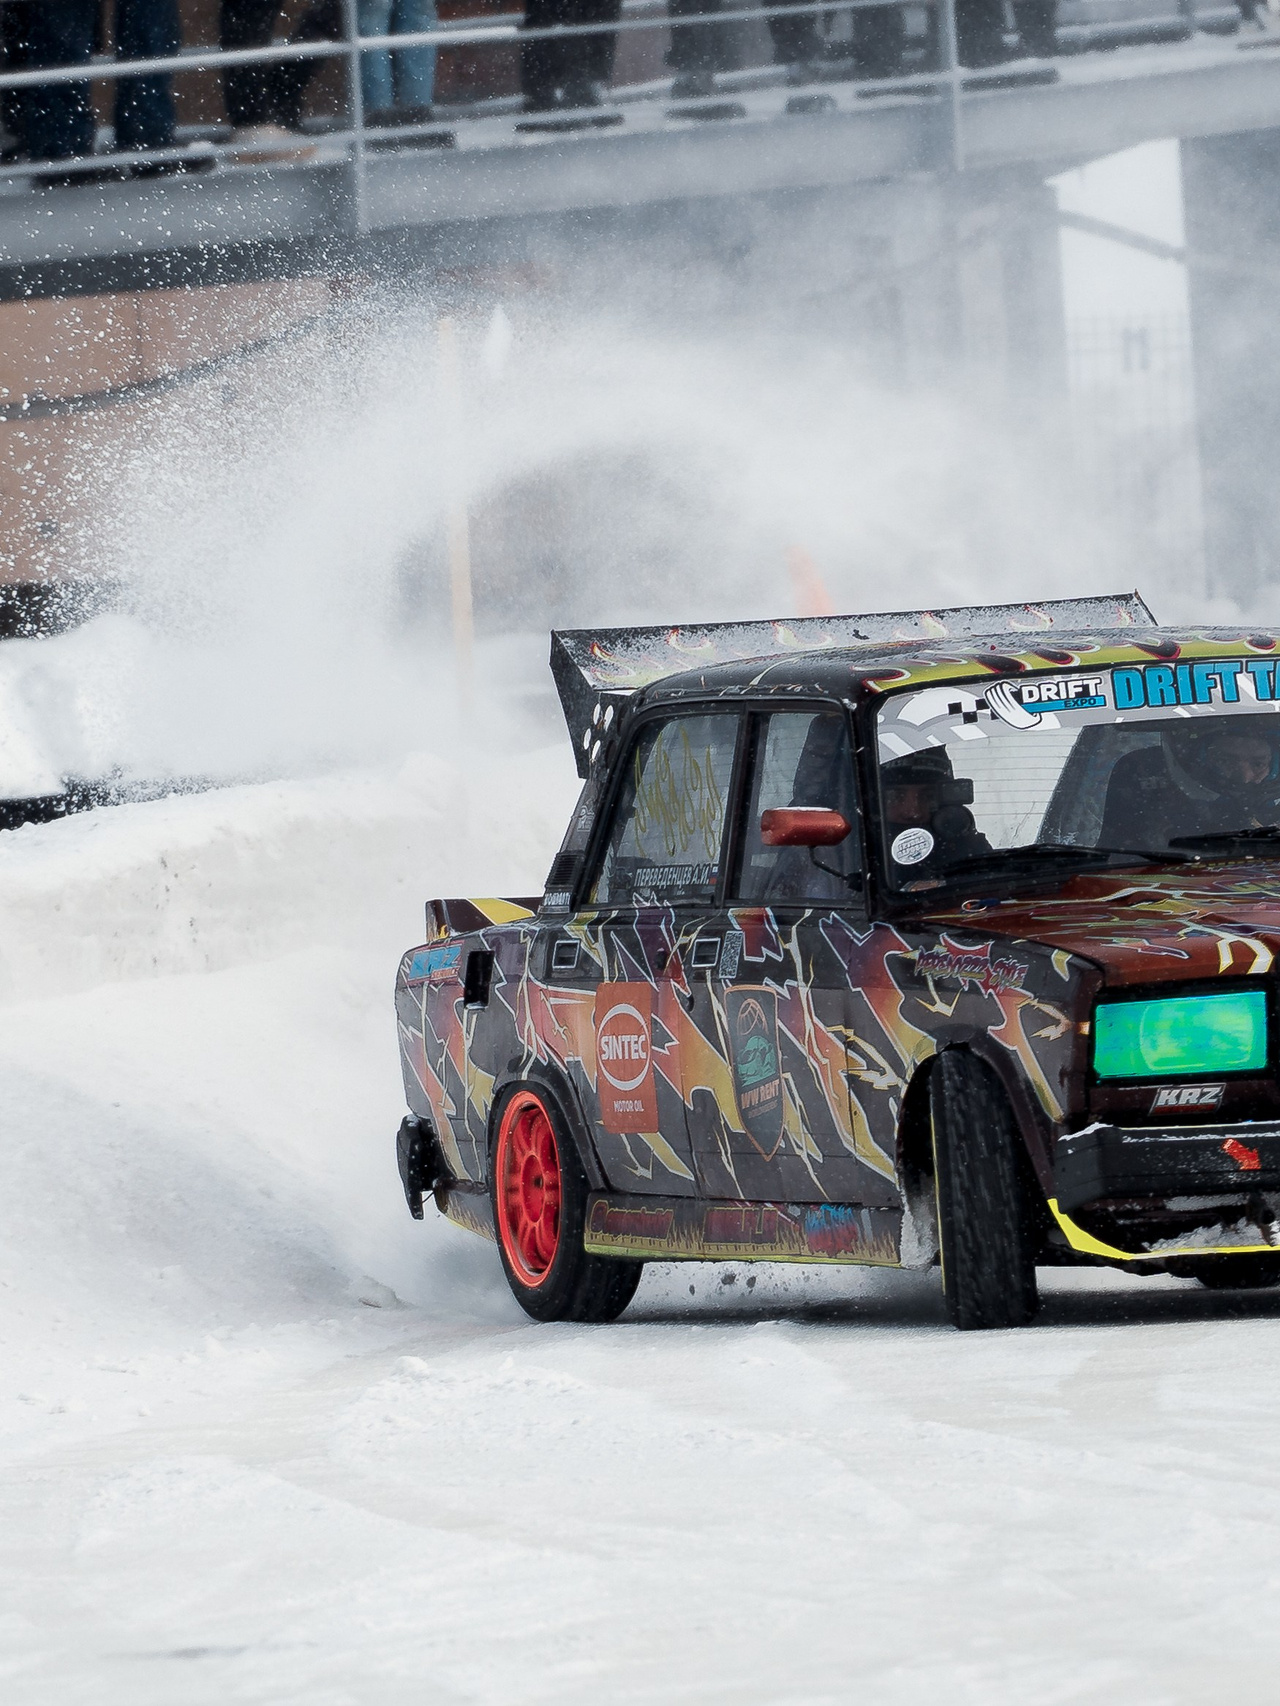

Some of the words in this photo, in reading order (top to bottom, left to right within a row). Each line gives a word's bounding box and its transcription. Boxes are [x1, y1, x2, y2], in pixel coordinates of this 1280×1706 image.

[1021, 676, 1102, 705] DRIFT
[1113, 661, 1244, 710] DRIFT
[1063, 696, 1098, 709] EXPO
[634, 866, 693, 889] ПЕРЕВЕДЕНЦЕВ
[601, 1034, 647, 1060] SINTEC
[613, 1100, 634, 1112] MOTOR
[634, 1100, 645, 1112] OIL
[741, 1088, 760, 1109] WW
[760, 1079, 780, 1102] RENT
[1156, 1087, 1221, 1106] KRZ
